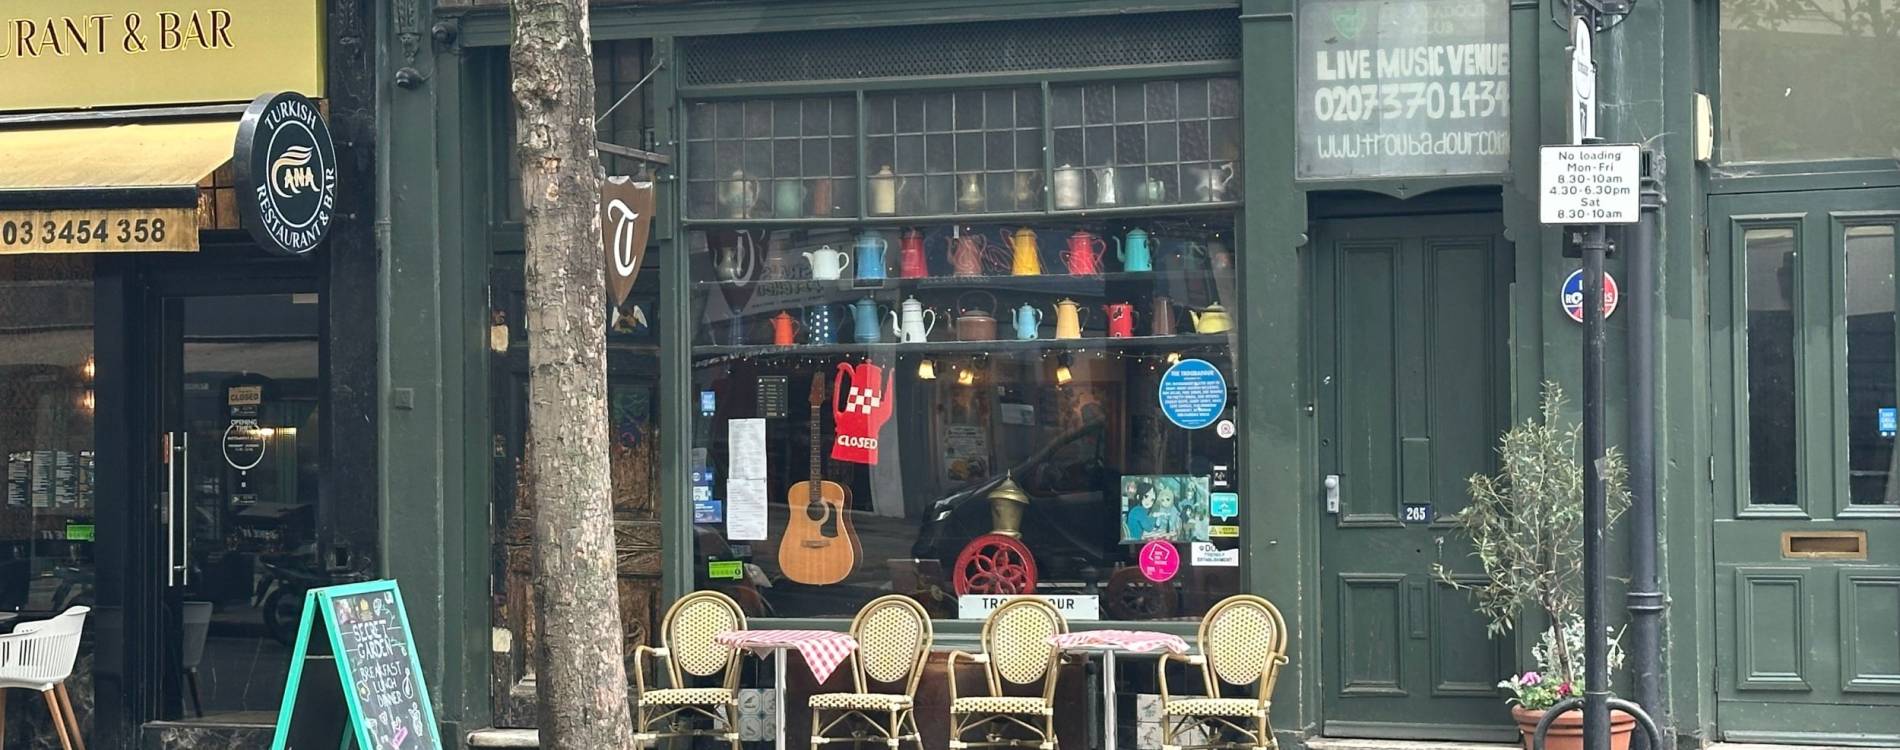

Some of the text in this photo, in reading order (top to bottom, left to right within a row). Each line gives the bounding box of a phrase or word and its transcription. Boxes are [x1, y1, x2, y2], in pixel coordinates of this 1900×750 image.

[122, 11, 147, 53] &
[158, 8, 236, 51] BAR
[1316, 43, 1509, 81] LIVE MUSIC VENUE
[1449, 80, 1509, 119] 1434
[264, 100, 317, 130] TURKISH
[1558, 151, 1621, 161] No loading
[256, 167, 335, 249] RESTAURANT & BAR
[1580, 197, 1600, 207] Sat
[3, 218, 166, 245] 03 3454 358
[607, 198, 639, 277] T
[230, 393, 259, 401] CLOSED
[837, 434, 878, 449] CLOSED
[982, 597, 1074, 610] TROOUR
[352, 619, 389, 642] SECRET
[357, 636, 394, 661] GARDEN
[360, 661, 402, 682] BREAKFAST
[372, 677, 397, 693] LUNCH
